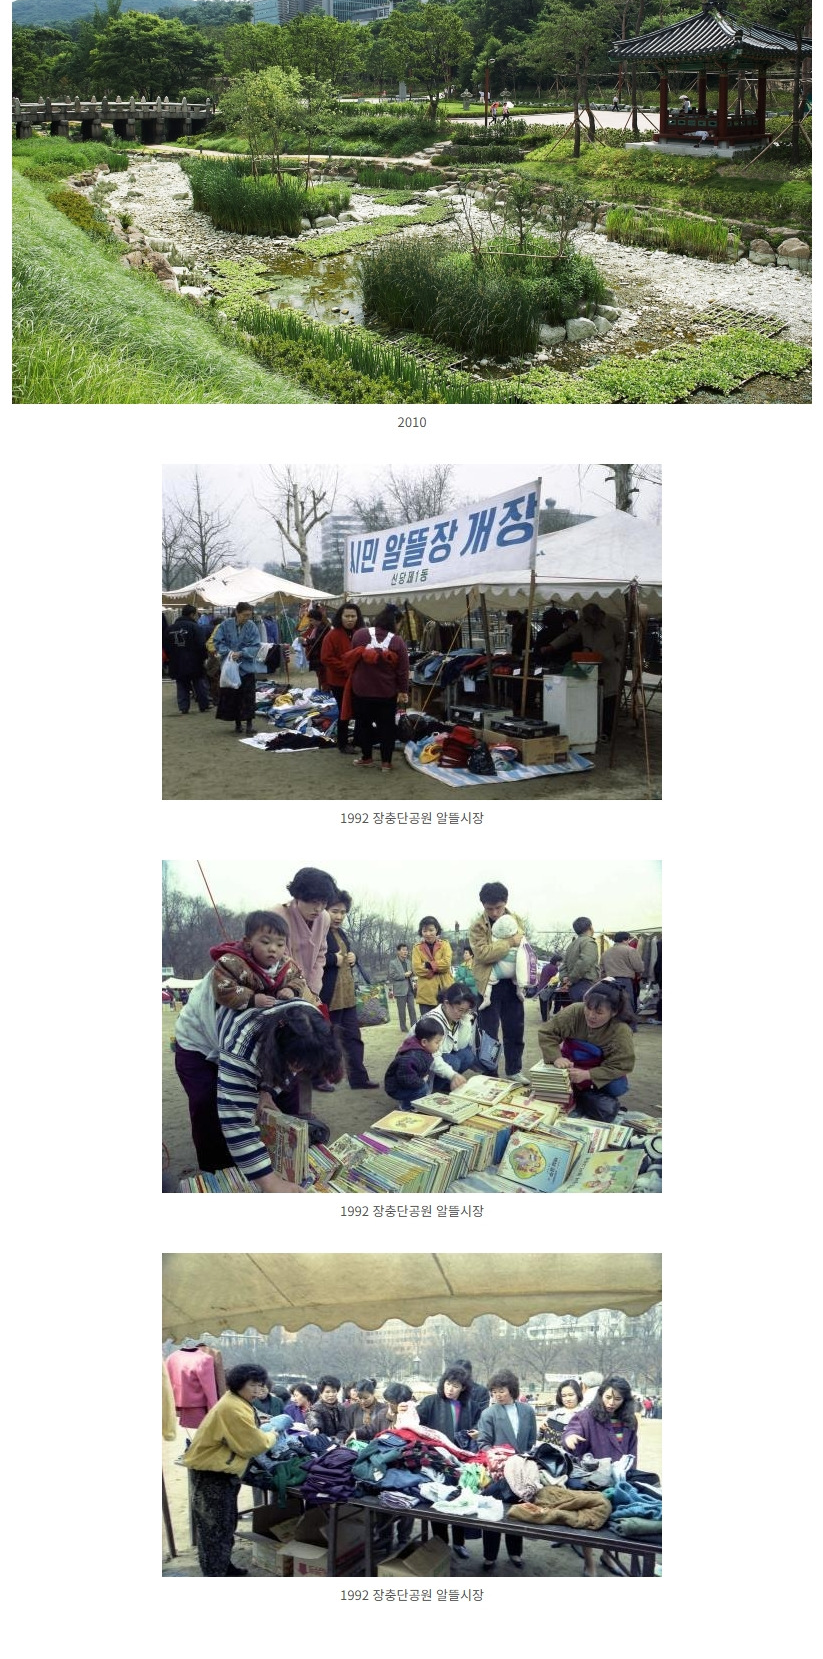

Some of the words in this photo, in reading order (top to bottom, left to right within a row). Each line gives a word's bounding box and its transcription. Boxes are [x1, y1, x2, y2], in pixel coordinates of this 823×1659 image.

[350, 537, 380, 574] 시민
[382, 519, 459, 572] 알뜰장
[459, 491, 538, 557] 개장
[390, 568, 429, 586] 신당제1동
